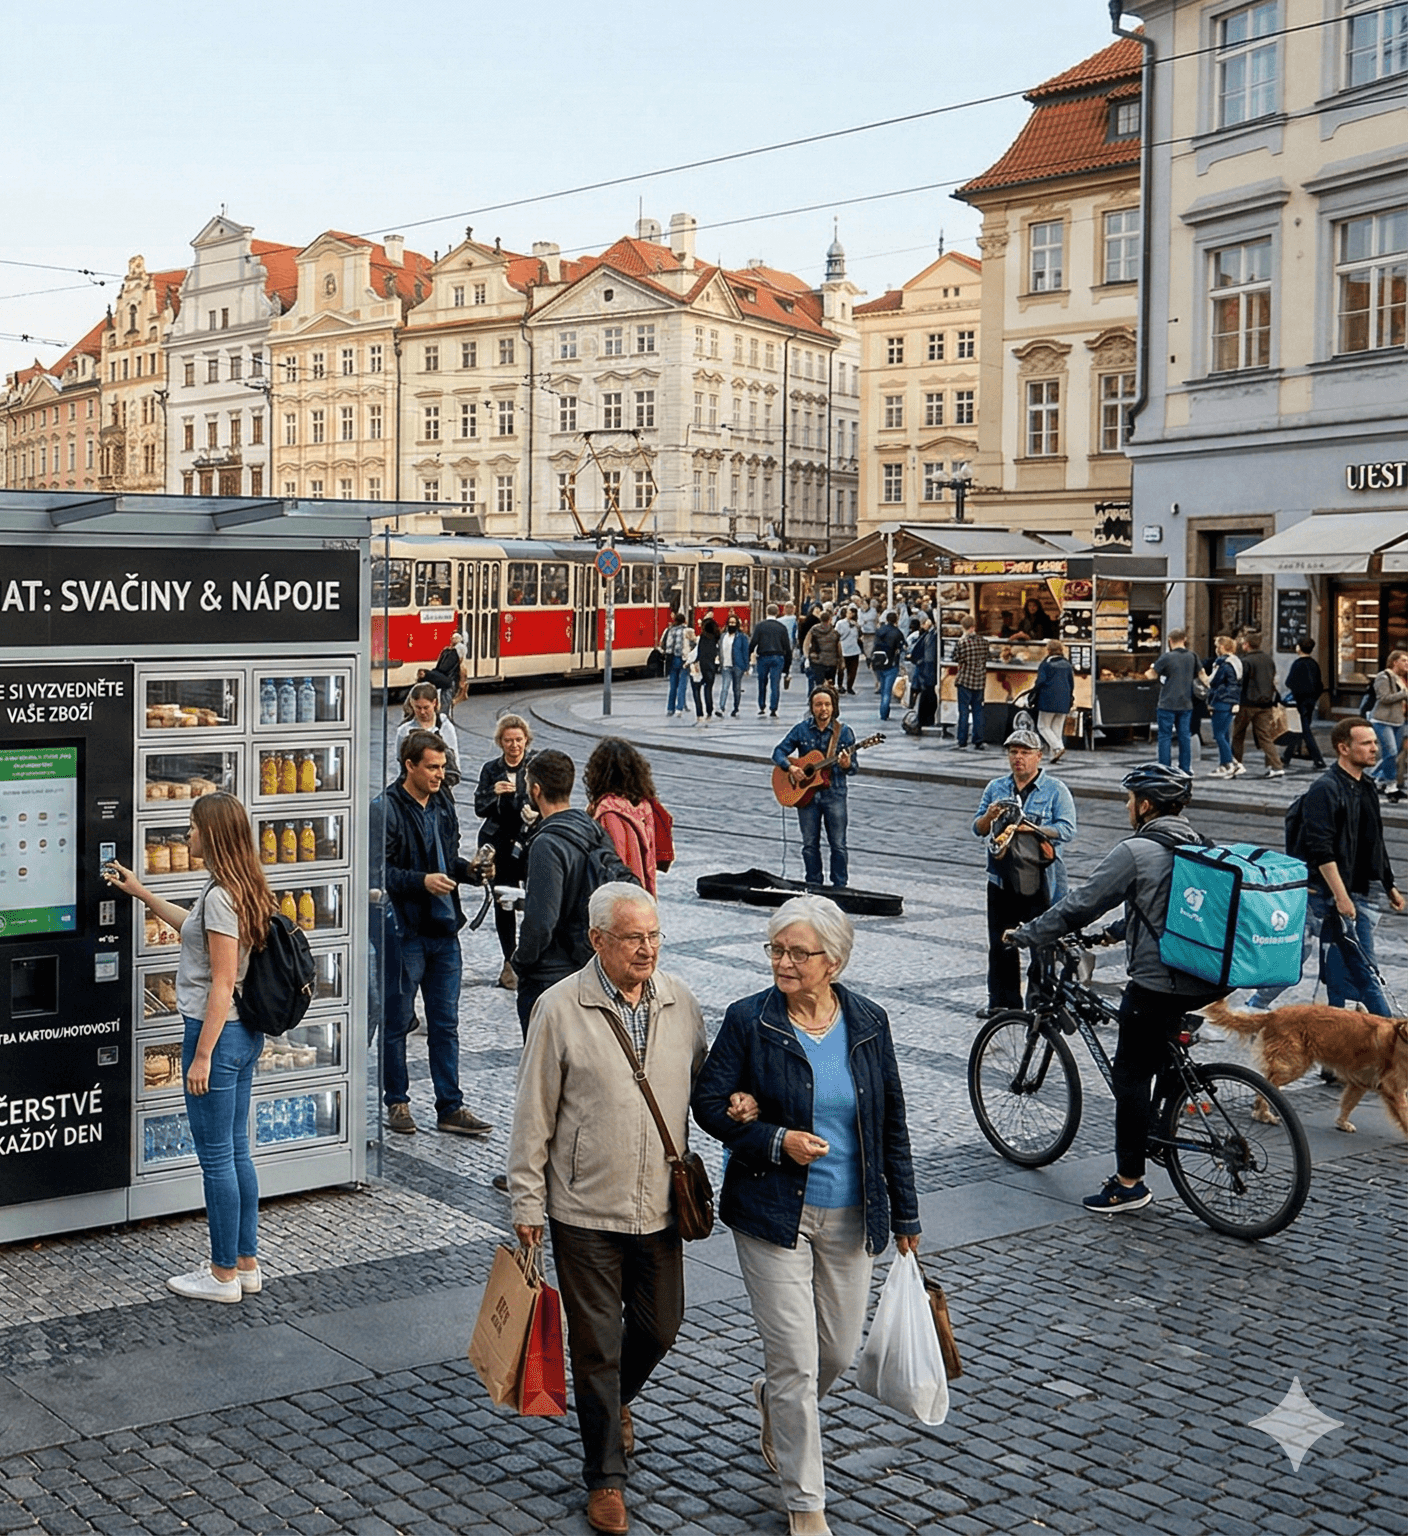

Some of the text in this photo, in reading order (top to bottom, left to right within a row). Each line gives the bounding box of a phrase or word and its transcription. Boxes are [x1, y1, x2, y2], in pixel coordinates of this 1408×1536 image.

[61, 573, 191, 611] SVAČINY
[200, 581, 221, 611] &
[233, 574, 339, 610] NÁPOJE
[10, 684, 22, 699] SI
[27, 678, 123, 698] VYZVEDNĚTE
[7, 702, 93, 723] VAŠE ZBOŽÍ
[64, 1122, 102, 1146] DEN
